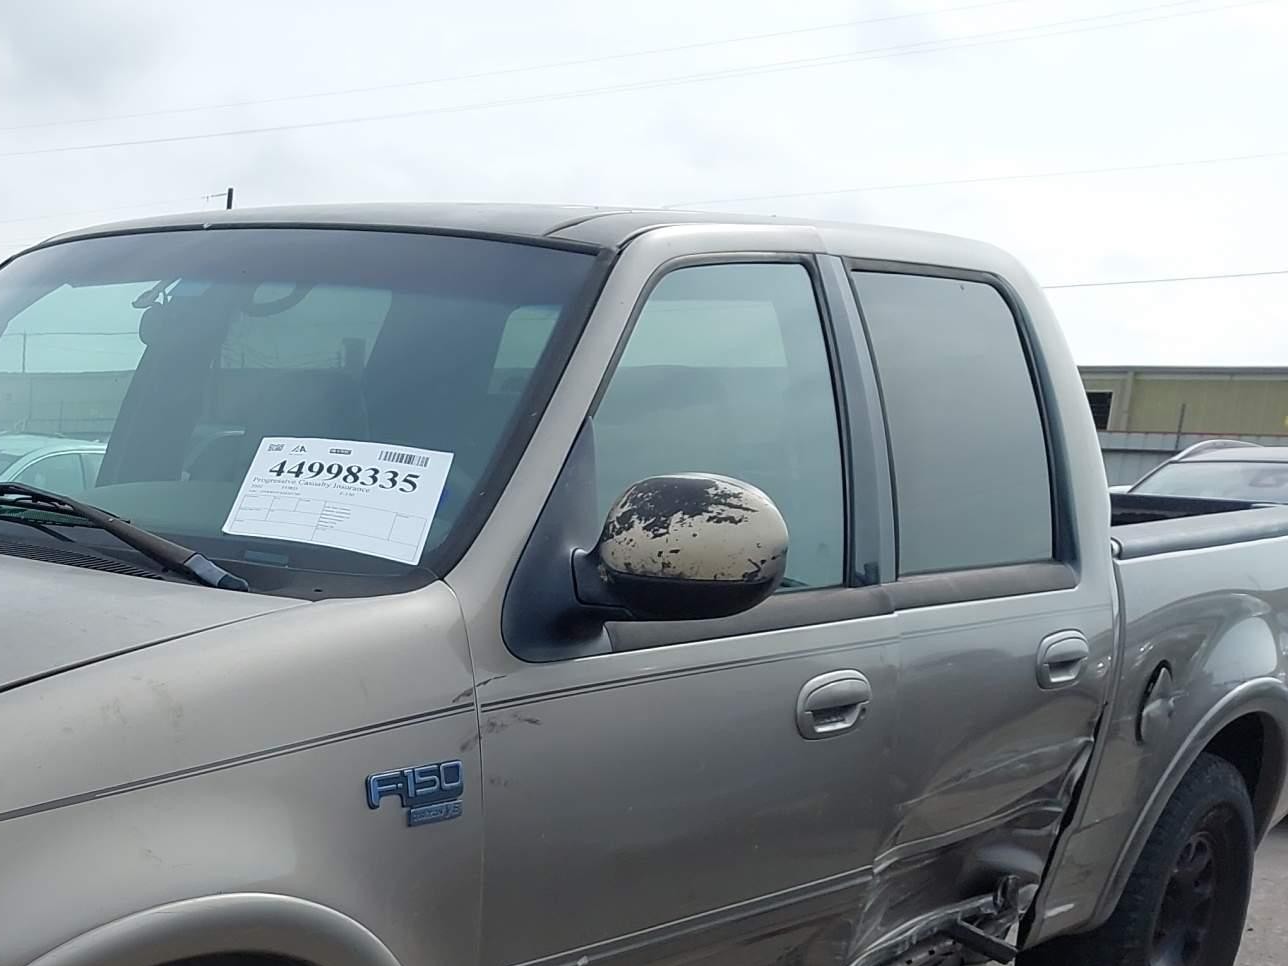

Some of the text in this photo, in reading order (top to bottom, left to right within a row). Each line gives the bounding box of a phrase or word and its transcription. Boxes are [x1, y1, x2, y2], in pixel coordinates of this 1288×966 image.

[253, 476, 370, 493] Progressive Casualty Insurance
[268, 459, 421, 494] 44998335
[369, 760, 463, 809] F-150
